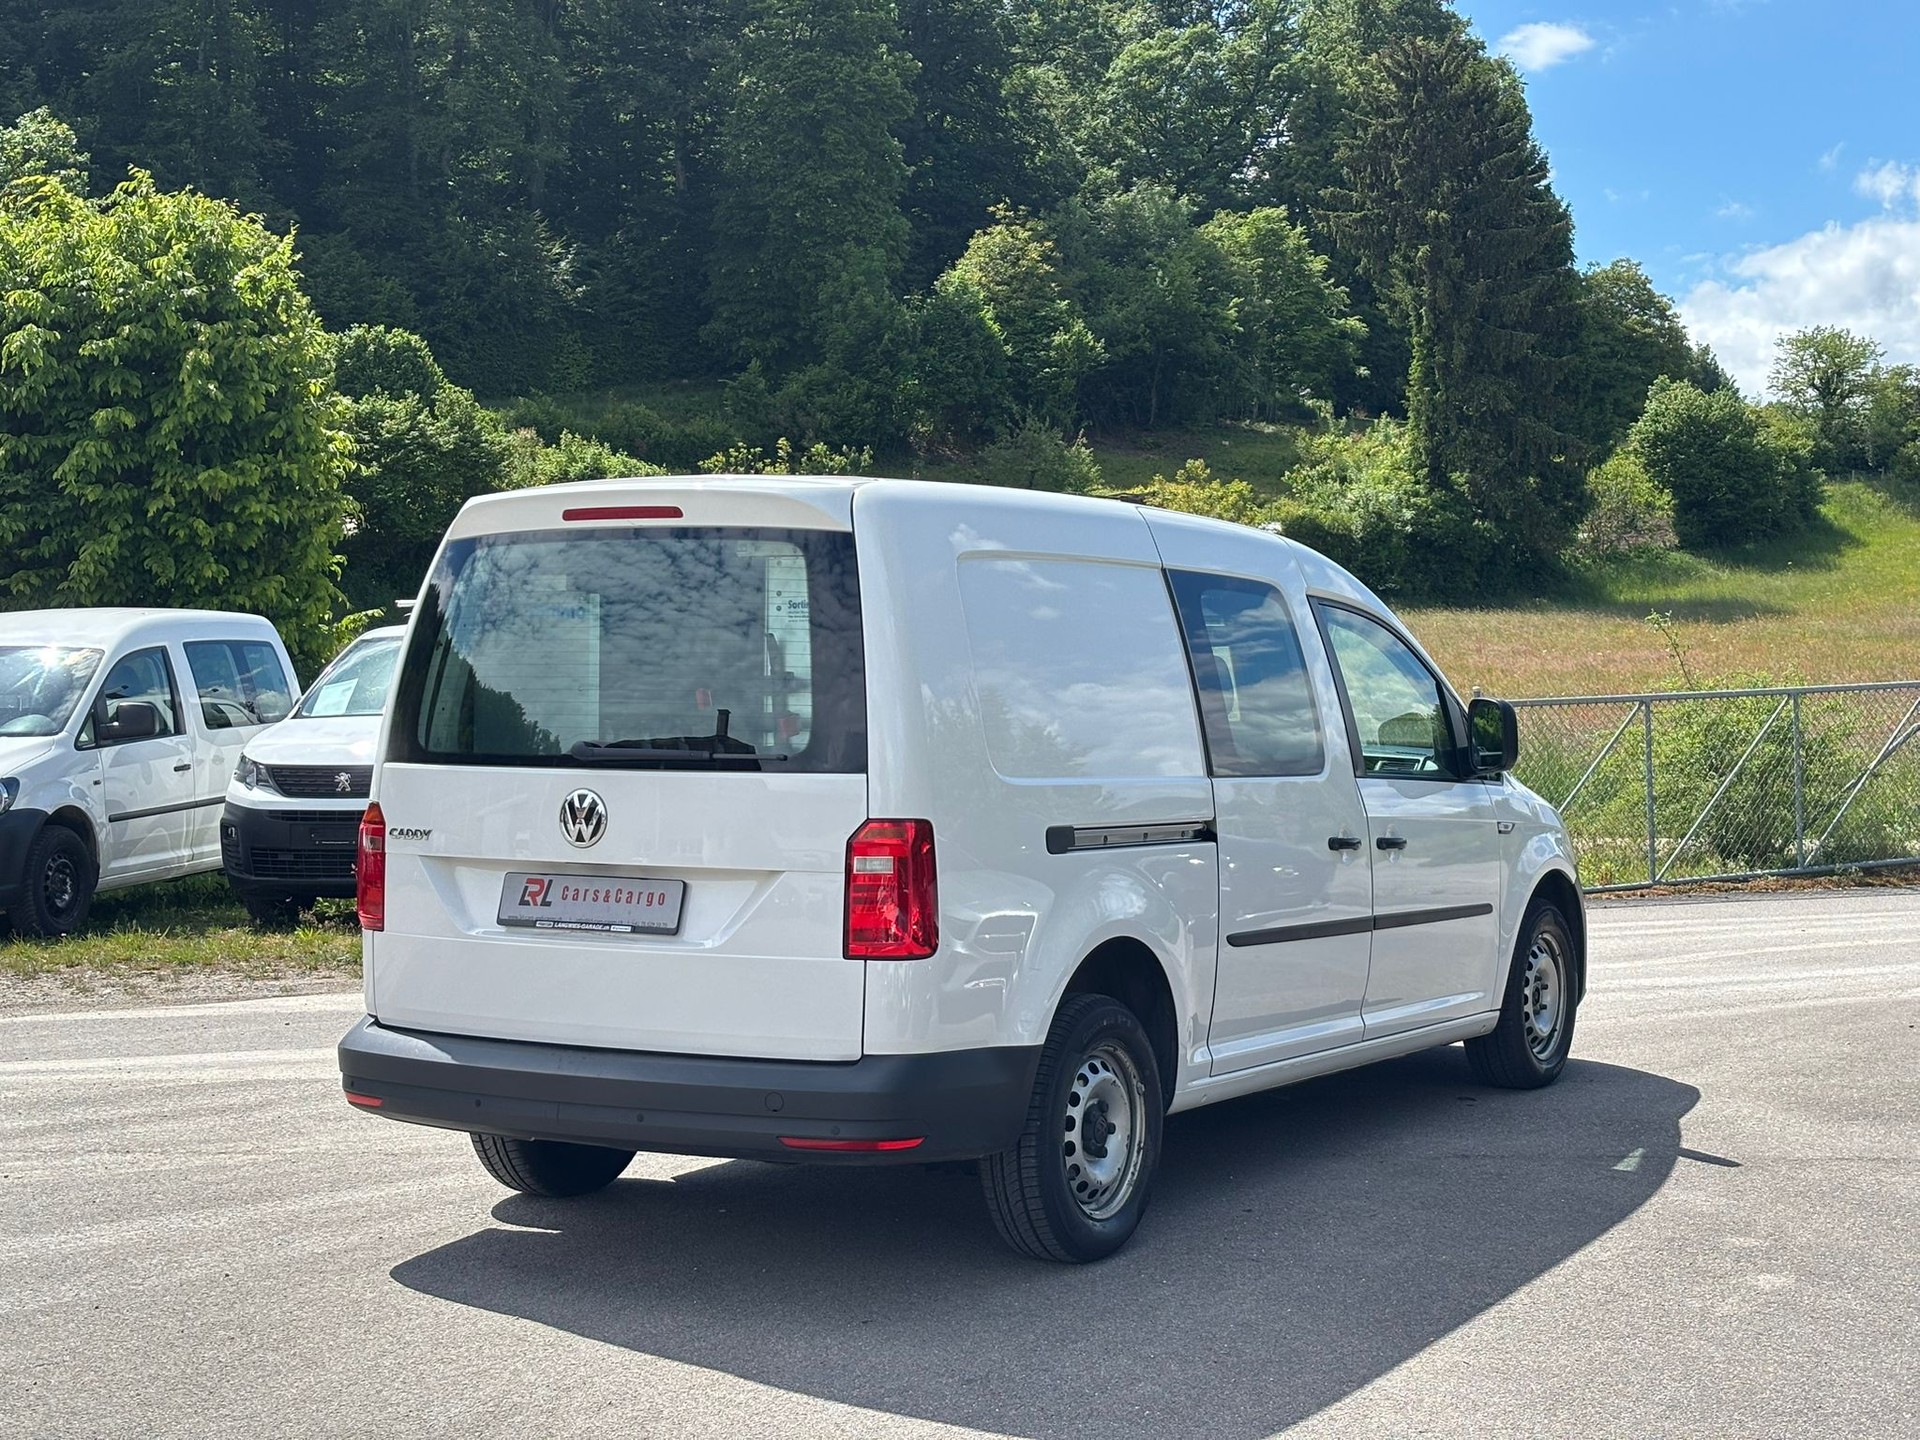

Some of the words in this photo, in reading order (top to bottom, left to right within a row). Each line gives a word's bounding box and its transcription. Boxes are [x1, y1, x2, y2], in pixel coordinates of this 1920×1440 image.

[560, 788, 608, 849] VW
[389, 827, 433, 841] CADDY
[561, 885, 666, 907] Cars&Cargo
